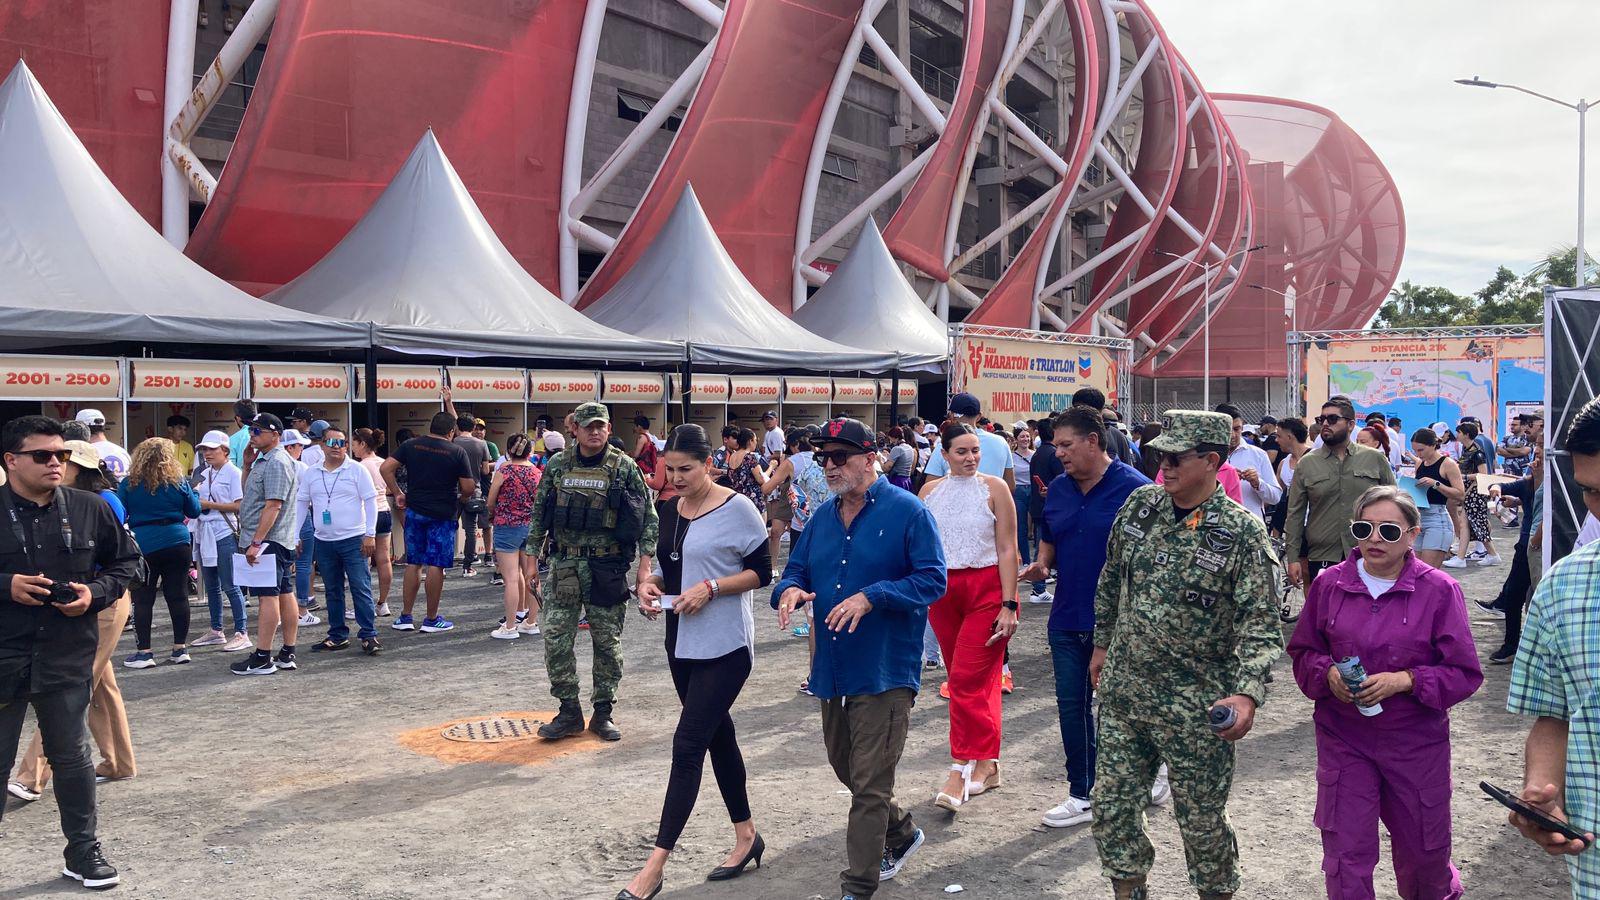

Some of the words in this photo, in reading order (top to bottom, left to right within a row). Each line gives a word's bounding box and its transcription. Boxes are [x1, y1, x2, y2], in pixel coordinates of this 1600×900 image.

[1371, 345, 1427, 353] DISTANCIA
[1429, 343, 1448, 352] 21K
[6, 371, 51, 385] 2001
[65, 373, 111, 386] 2500
[144, 375, 180, 388] 2501
[193, 376, 233, 389] 3000
[263, 377, 296, 388] 3001
[307, 378, 341, 389] 3500
[1047, 375, 1075, 383] SKECHERS
[376, 379, 394, 389] 501
[404, 379, 436, 389] 4000
[456, 380, 483, 390] 4001
[492, 381, 520, 390] 4500
[538, 383, 560, 392] 4501
[568, 383, 593, 392] 5000
[610, 384, 631, 393] 5001
[638, 384, 660, 393] 5500
[703, 385, 724, 394] 6000
[759, 387, 777, 395] 6500
[812, 387, 829, 395] 7000
[840, 387, 853, 395] 7001
[858, 388, 873, 396] 7500
[1032, 392, 1053, 412] CORRE
[564, 479, 604, 488] EJERCITO
